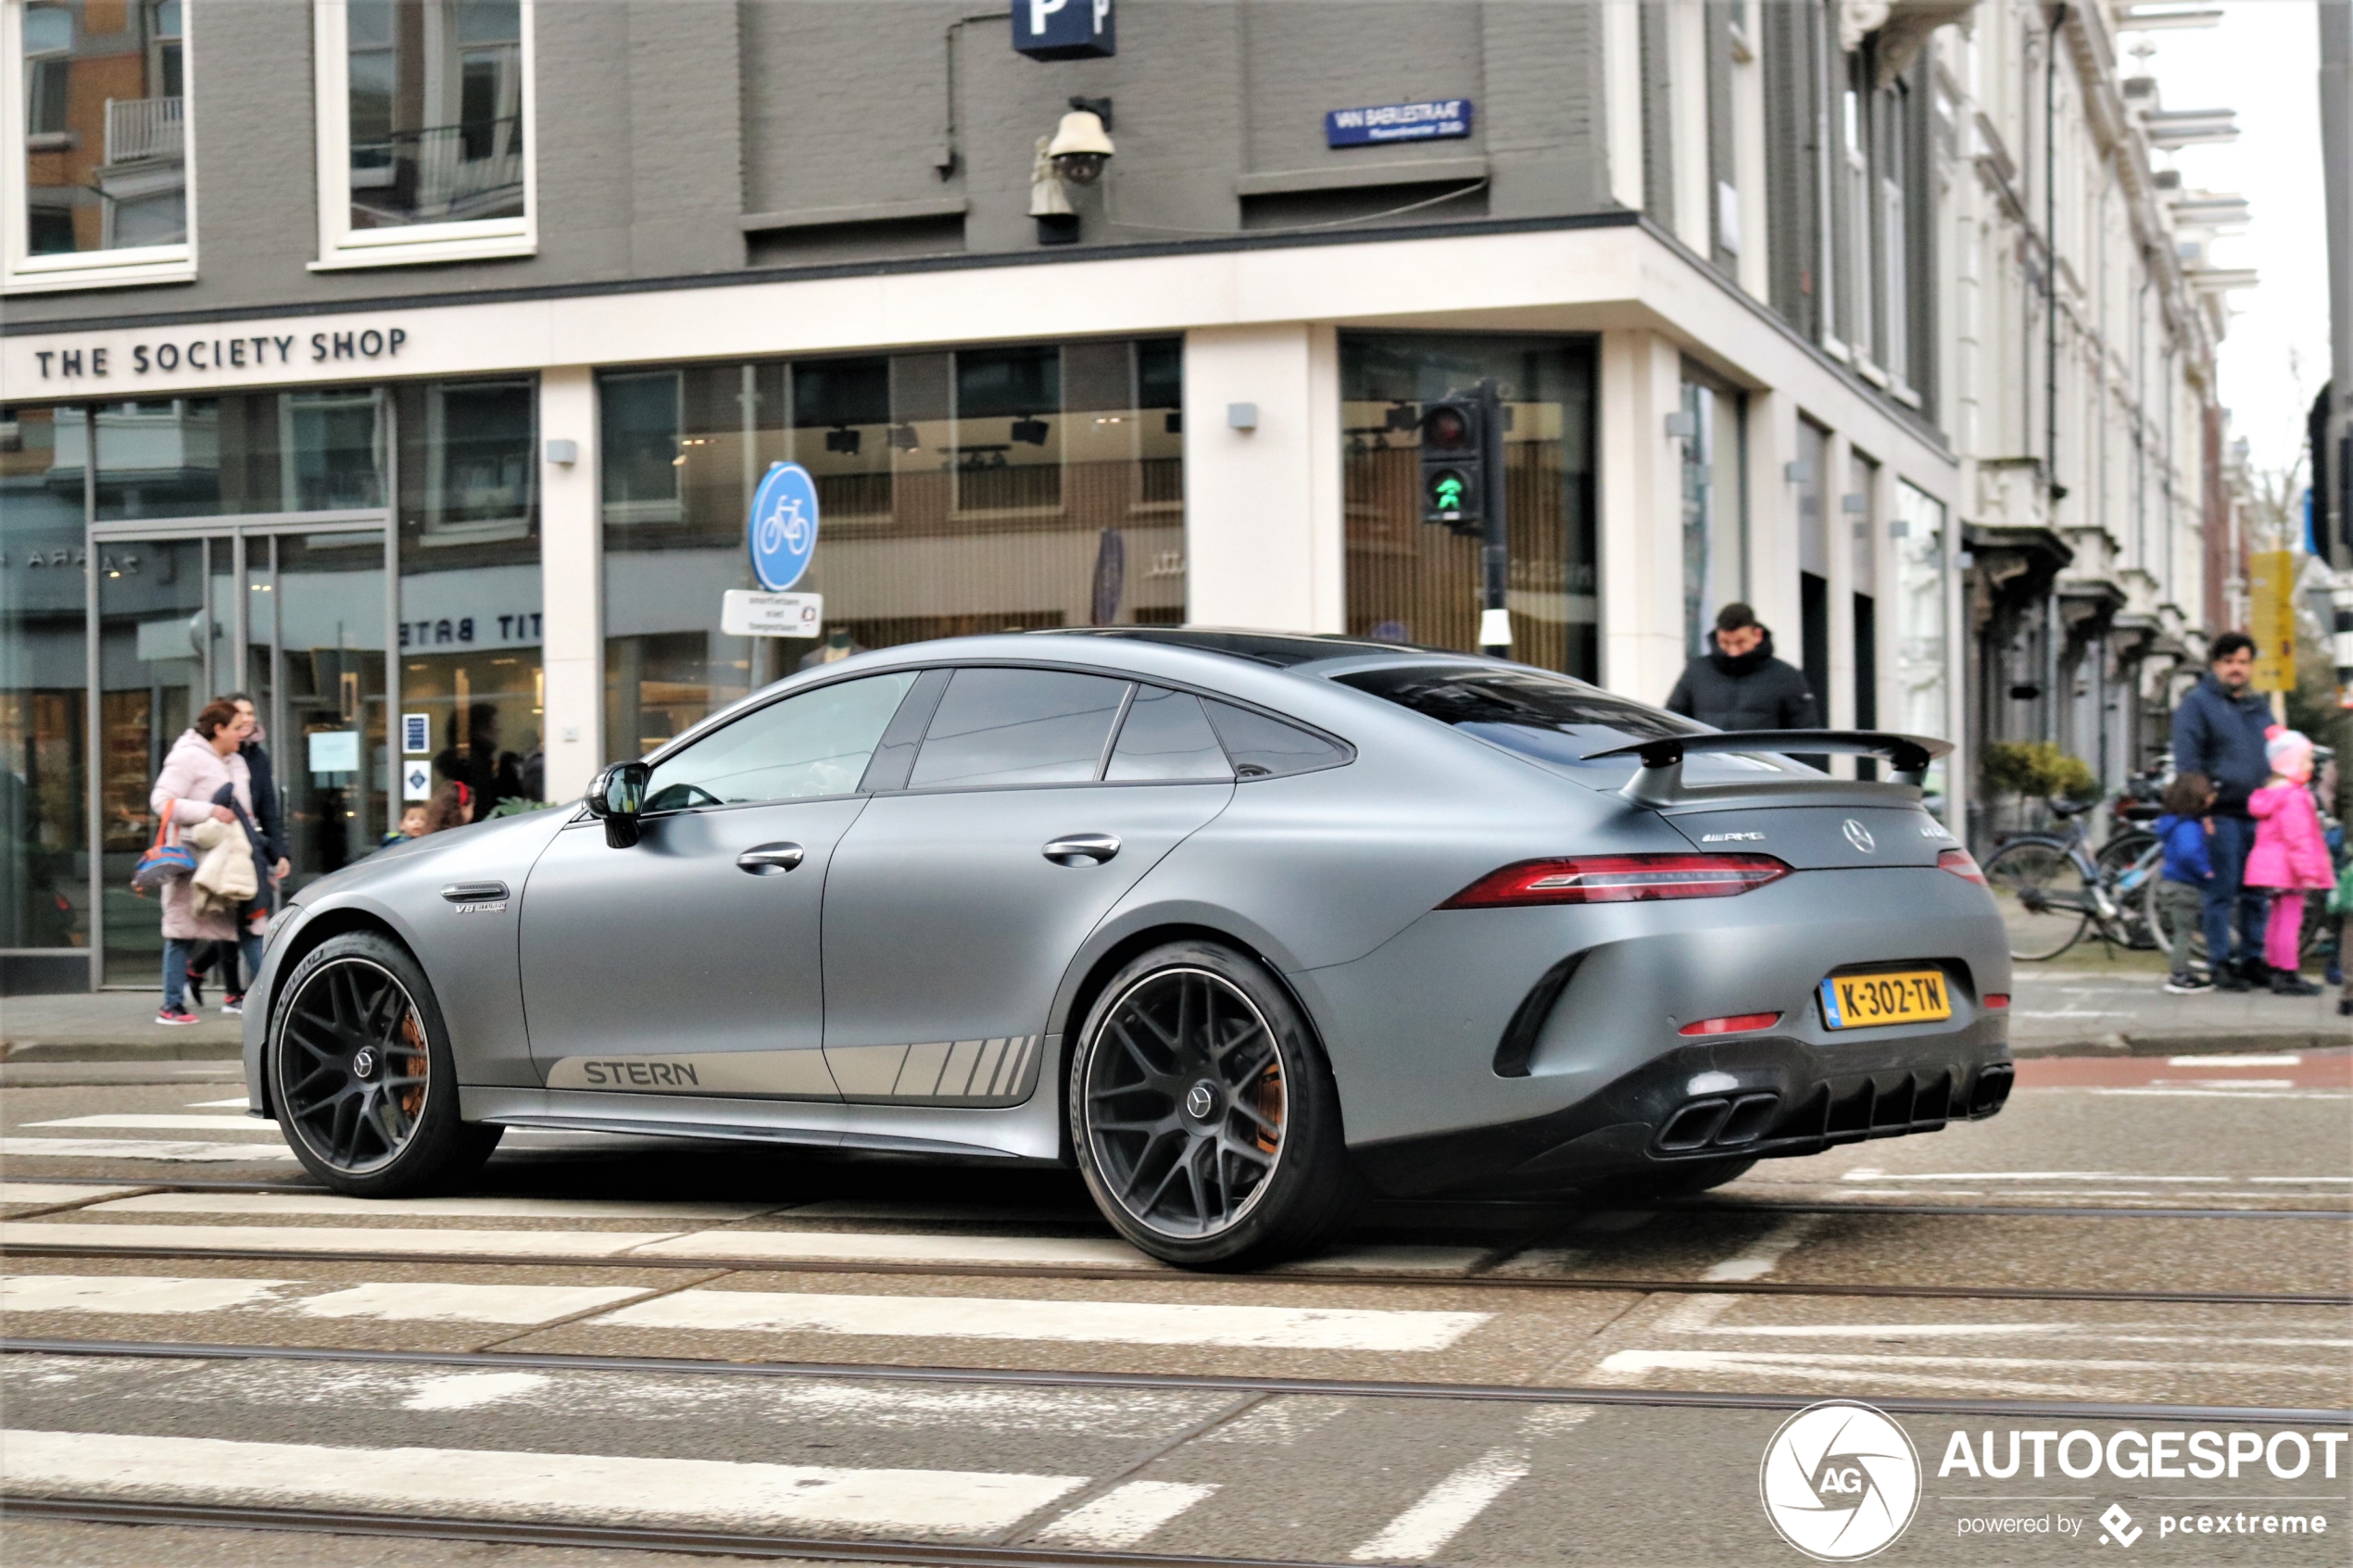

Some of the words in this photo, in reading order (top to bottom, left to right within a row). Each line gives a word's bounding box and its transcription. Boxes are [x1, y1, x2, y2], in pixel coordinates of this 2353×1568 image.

[1029, 0, 1066, 36] P
[1092, 0, 1111, 35] P
[1333, 110, 1365, 129] VAN
[36, 347, 107, 378] THE
[133, 335, 294, 374] SOCIETY
[311, 328, 408, 362] SHOP
[455, 904, 474, 914] V8
[1842, 978, 1943, 1018] K-302-TN
[584, 1061, 699, 1086] STERN
